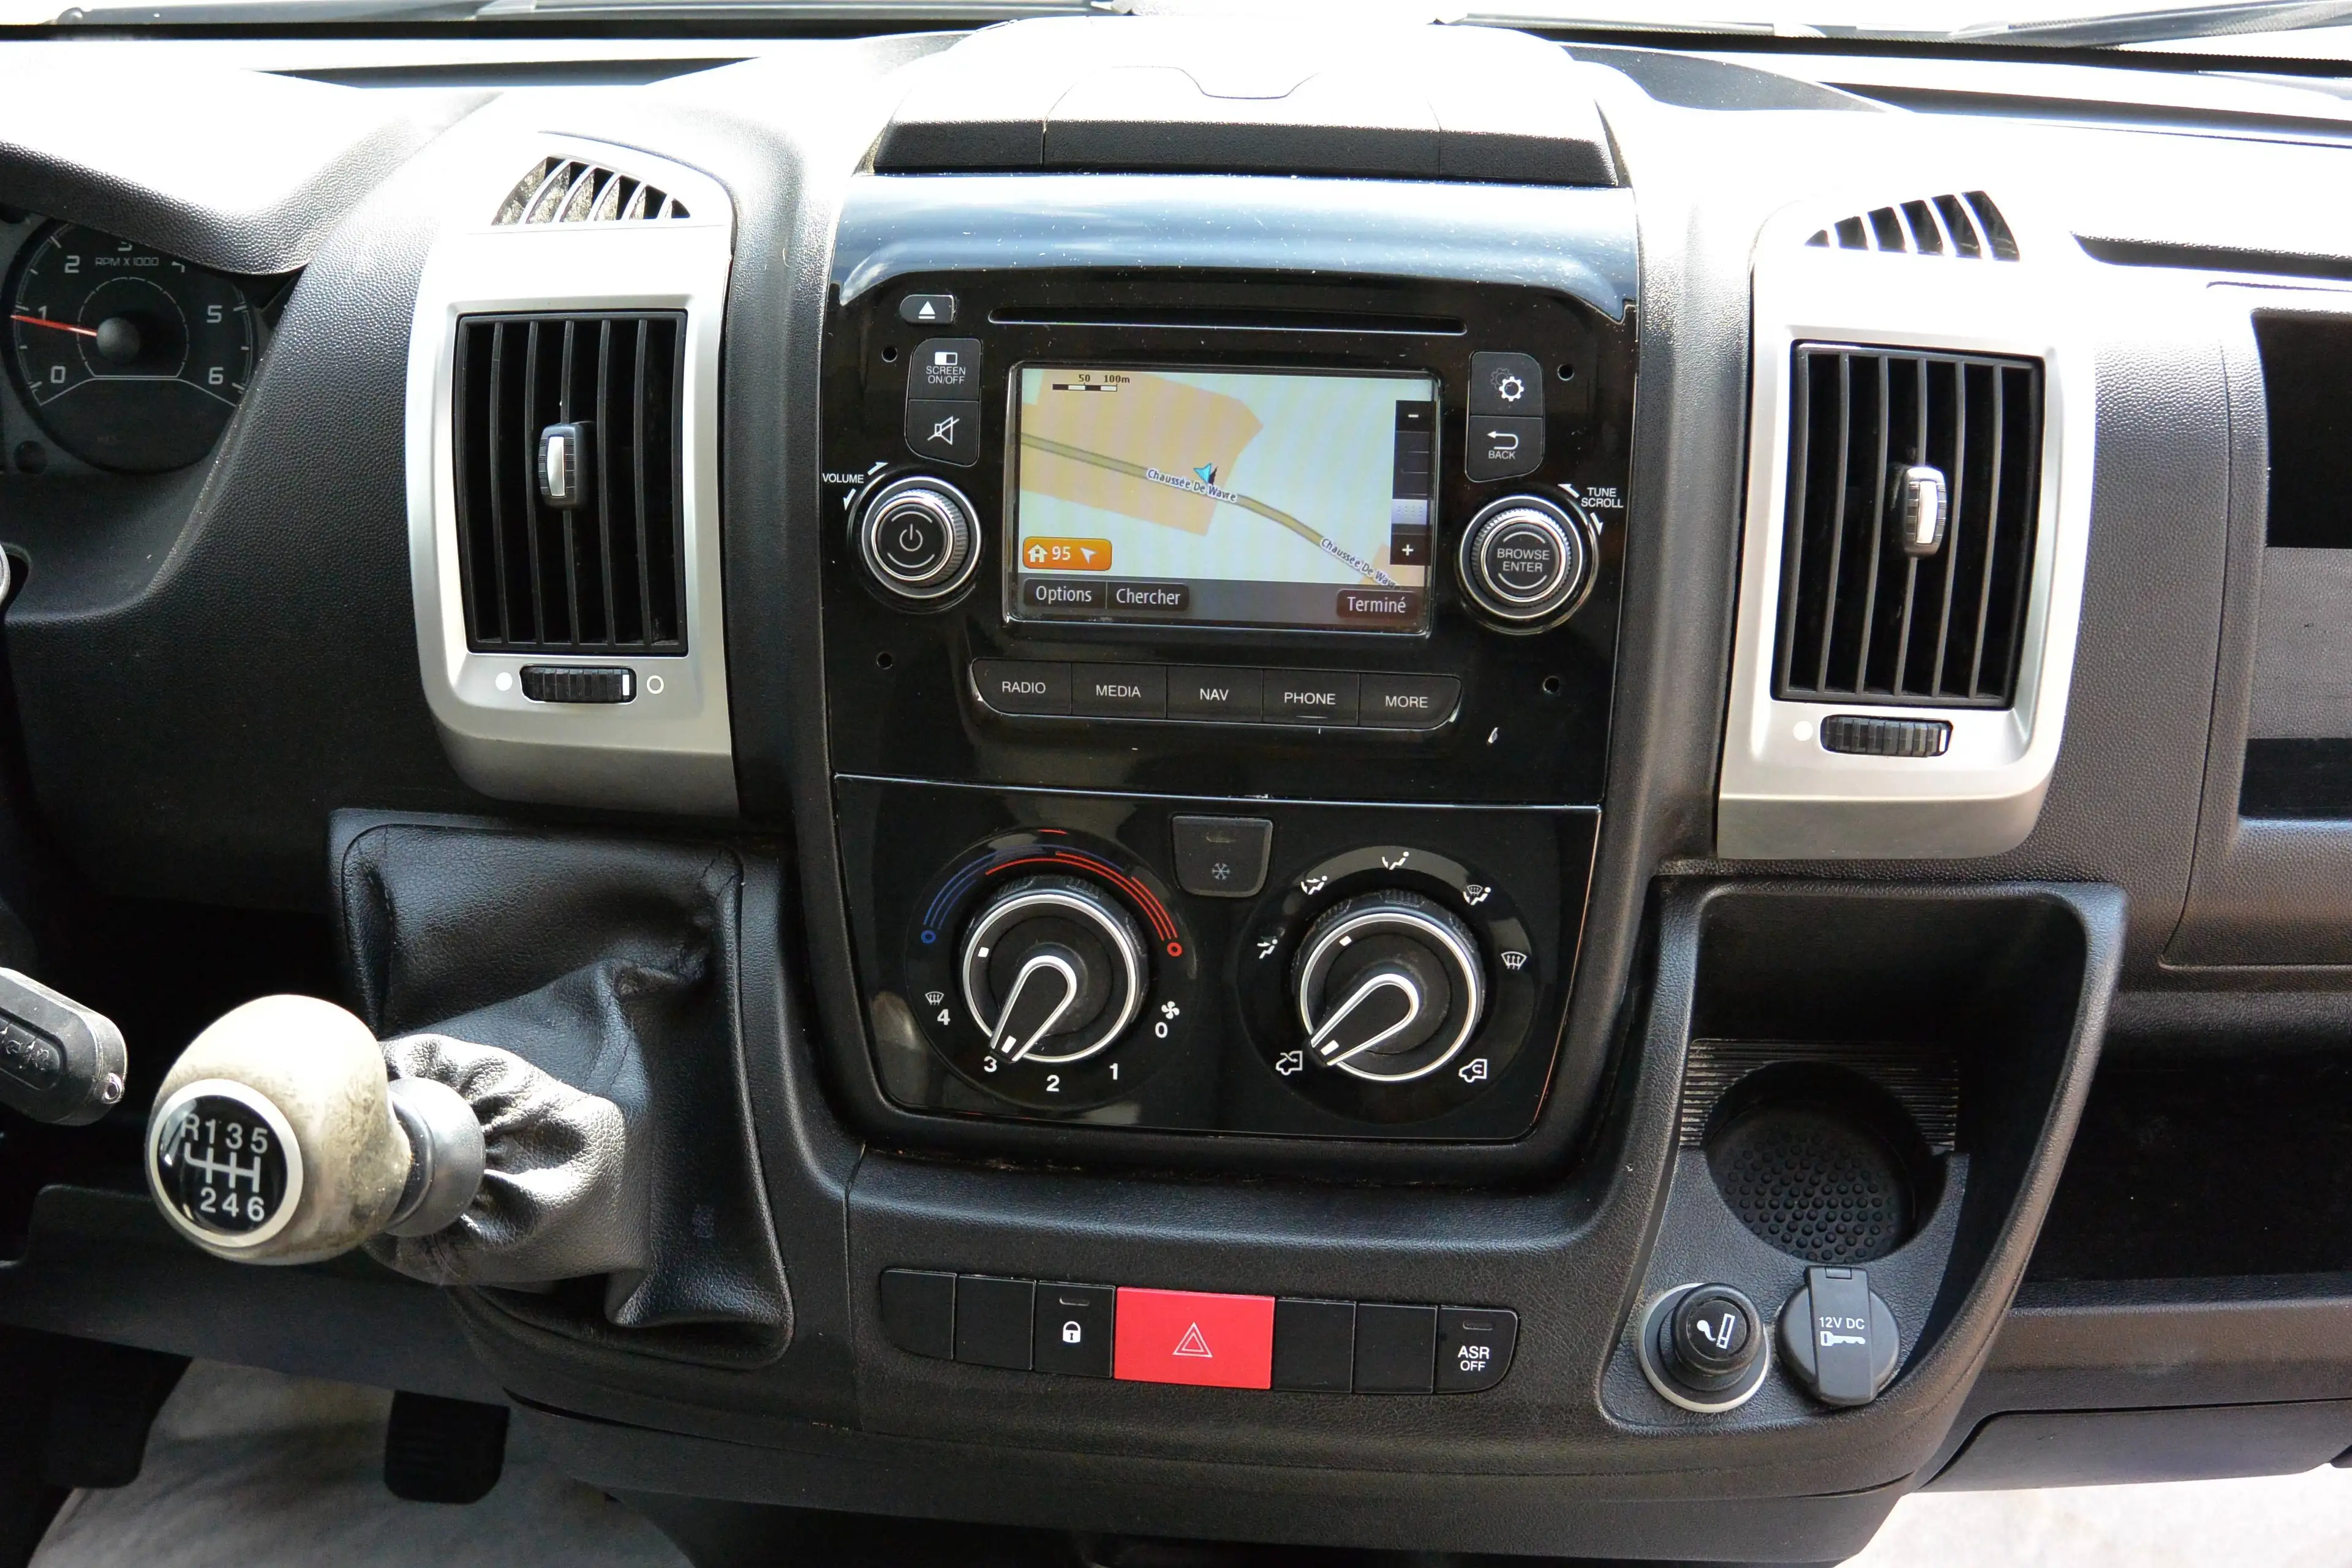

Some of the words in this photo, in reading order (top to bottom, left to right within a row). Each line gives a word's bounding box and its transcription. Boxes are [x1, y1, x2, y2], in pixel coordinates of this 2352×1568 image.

[64, 255, 80, 273] 2
[95, 257, 120, 266] RPM
[123, 257, 130, 266] X
[133, 257, 159, 266] 1000
[206, 305, 222, 323] 5
[50, 366, 66, 383] 0
[208, 367, 224, 385] 6
[925, 366, 966, 375] SCREEN
[927, 375, 965, 385] ON/OFF
[1078, 374, 1091, 383] 50
[1103, 374, 1131, 383] 100m
[1488, 450, 1516, 460] BACK
[822, 473, 864, 484] VOLUME
[1148, 469, 1191, 489] Chaussée
[1193, 482, 1205, 492] De
[1208, 486, 1236, 502] Wavre
[1587, 487, 1617, 497] TUNE
[1580, 497, 1624, 509] SCROLL
[1052, 546, 1071, 561] 95
[1322, 538, 1360, 567] Chaussée
[1362, 563, 1373, 576] De
[1496, 548, 1550, 561] BROWSE
[1502, 560, 1543, 573] ENTER
[1036, 586, 1092, 605] Options
[1116, 587, 1181, 605] Chercher
[1347, 596, 1406, 613] Terminé
[1001, 680, 1046, 694] RADIO
[1095, 684, 1141, 698] MEDIA
[1199, 688, 1229, 701] NAV
[1284, 692, 1336, 706] PHONE
[1385, 695, 1428, 709] MORE
[937, 1008, 951, 1025] 4
[1155, 1021, 1168, 1038] 0
[983, 1055, 998, 1072] 3
[1109, 1063, 1119, 1080] 1
[1046, 1074, 1060, 1092] 2
[1819, 1316, 1843, 1329] 12V
[1845, 1317, 1866, 1330] DC
[1457, 1345, 1490, 1359] ASR
[1460, 1360, 1486, 1371] OFF
